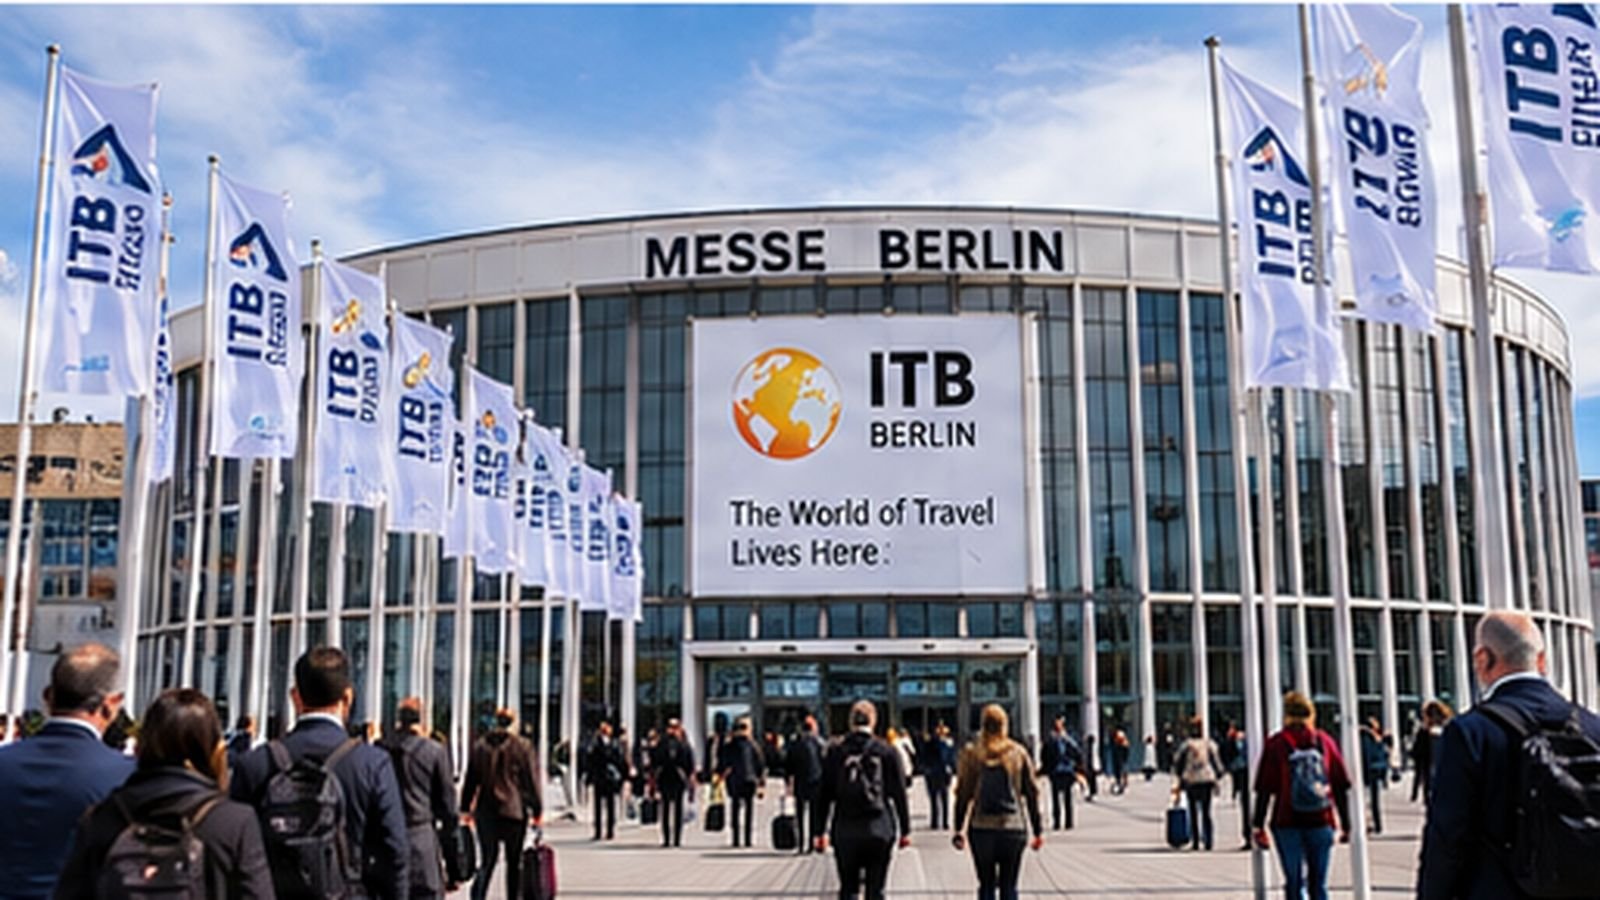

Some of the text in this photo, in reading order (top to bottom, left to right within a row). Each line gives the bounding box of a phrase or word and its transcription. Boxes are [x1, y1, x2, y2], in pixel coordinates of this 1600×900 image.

[1502, 25, 1564, 143] ITB
[66, 194, 118, 284] ITB
[645, 229, 1064, 278] MESSE BERLIN
[1252, 188, 1296, 278] ITB
[227, 282, 265, 361] ITB
[327, 346, 358, 418] ITB
[870, 351, 975, 408] ITB
[870, 421, 976, 448] BERLIN
[730, 497, 995, 527] The World of Travel
[731, 538, 800, 567] Lives
